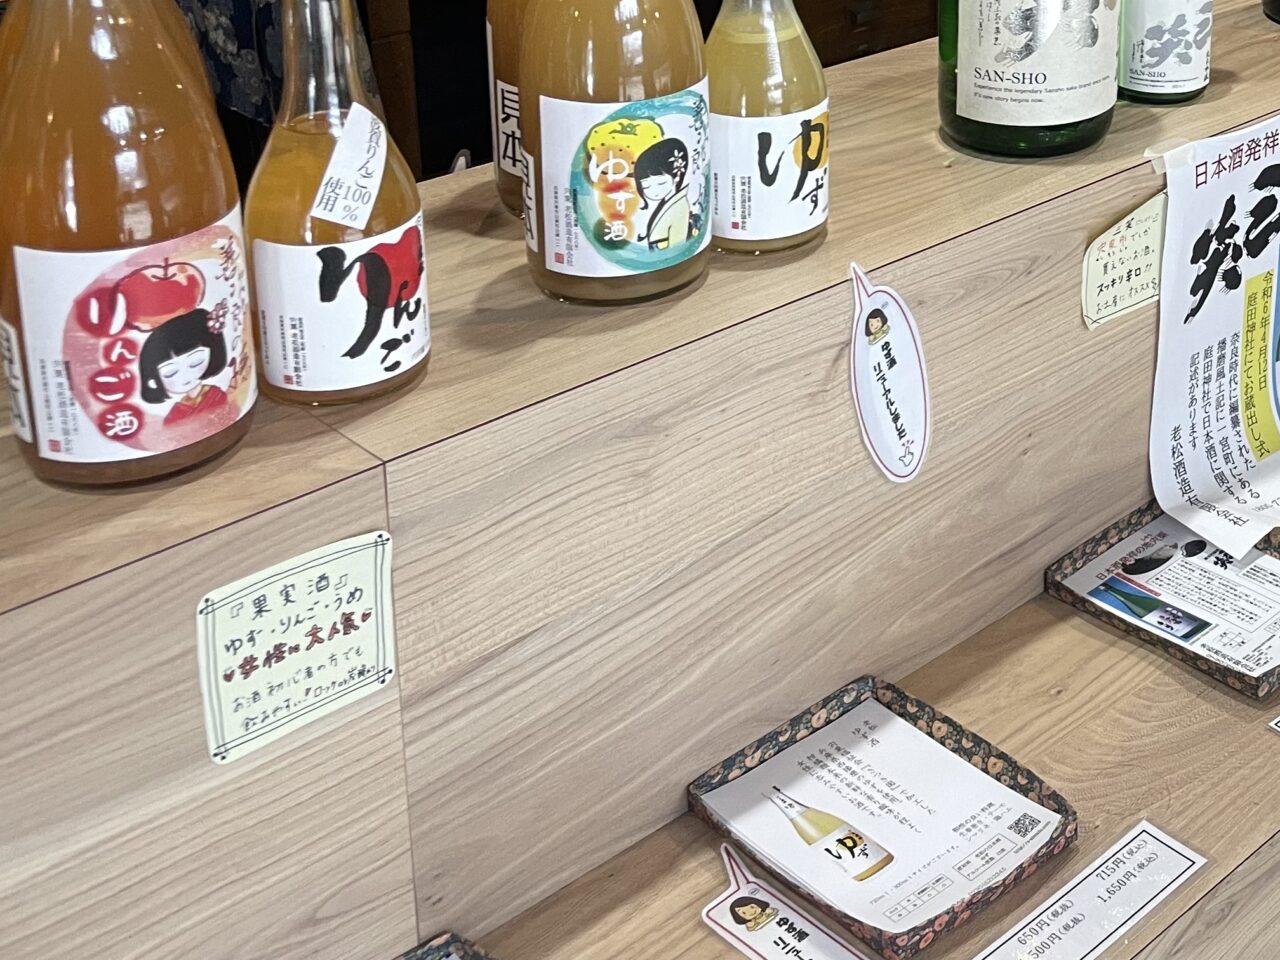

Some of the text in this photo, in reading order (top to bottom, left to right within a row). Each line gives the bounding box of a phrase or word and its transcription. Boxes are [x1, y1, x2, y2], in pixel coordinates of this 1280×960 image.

[973, 66, 1047, 86] SAN-SHO
[1129, 67, 1166, 79] SAN-SHO
[315, 177, 344, 214] 使用
[588, 149, 636, 242] ゆず酒
[316, 245, 423, 372] りんご
[1257, 270, 1275, 390] 令和6年4月12日
[88, 292, 139, 438] りんご酒
[1188, 351, 1201, 452] 記述があります
[1215, 337, 1261, 500] 播磨風土記に一宮町にある
[1229, 331, 1256, 472] 奈良時代に編纂された
[1243, 291, 1271, 458] 庭田神社にてお蔵出し式
[1170, 424, 1250, 528] 老松酒造有限会社
[1202, 345, 1248, 505] 庭田神社で日本酒に関する
[1017, 839, 1148, 946] 650円(税抜) 715円(税込)
[1096, 852, 1159, 904] 1,650円(税込)
